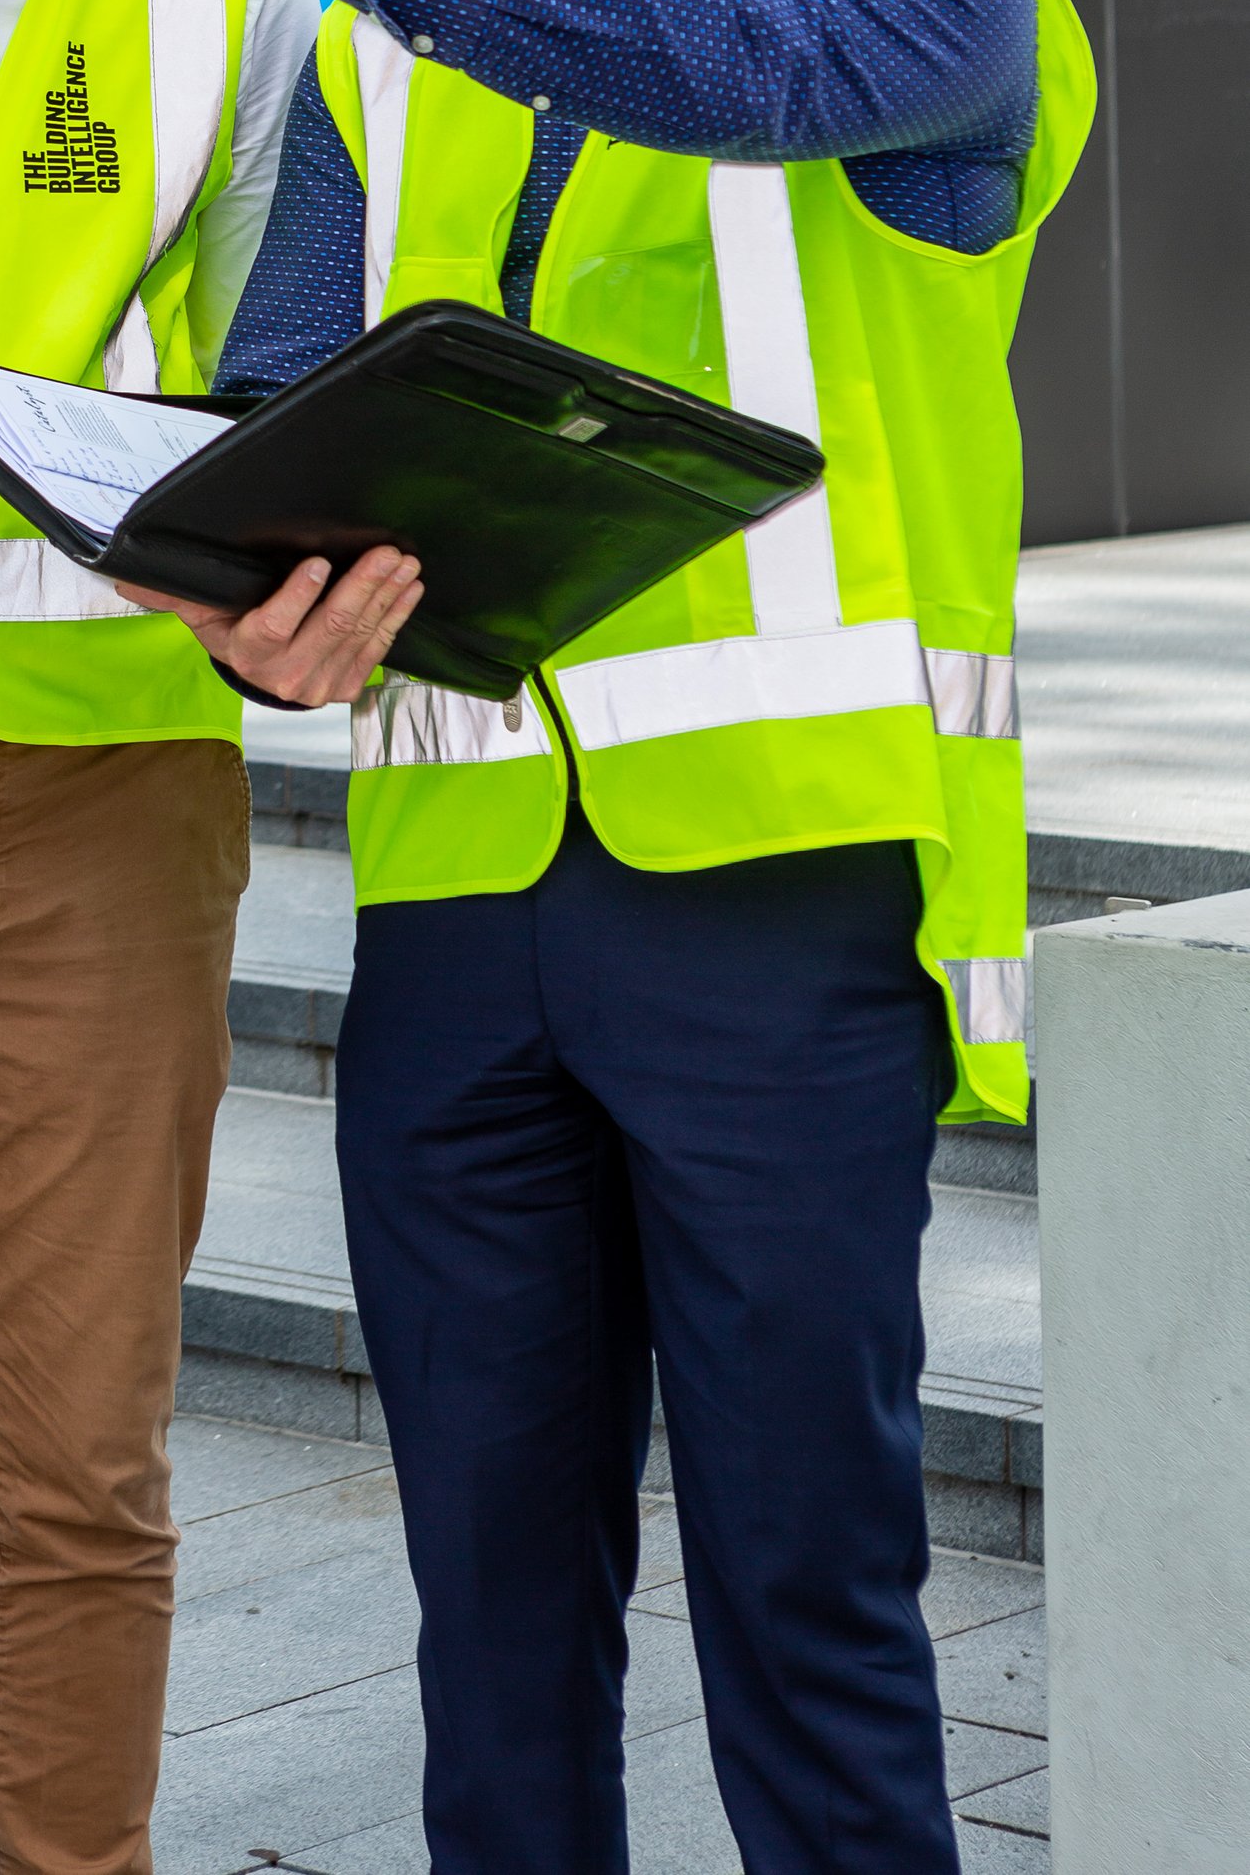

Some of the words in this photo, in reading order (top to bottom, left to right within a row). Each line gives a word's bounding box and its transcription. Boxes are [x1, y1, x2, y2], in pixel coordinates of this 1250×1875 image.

[45, 90, 72, 193] BUILDING
[66, 41, 97, 193] INTELLIGENCE
[92, 121, 121, 194] GROUP
[23, 150, 48, 193] THE
